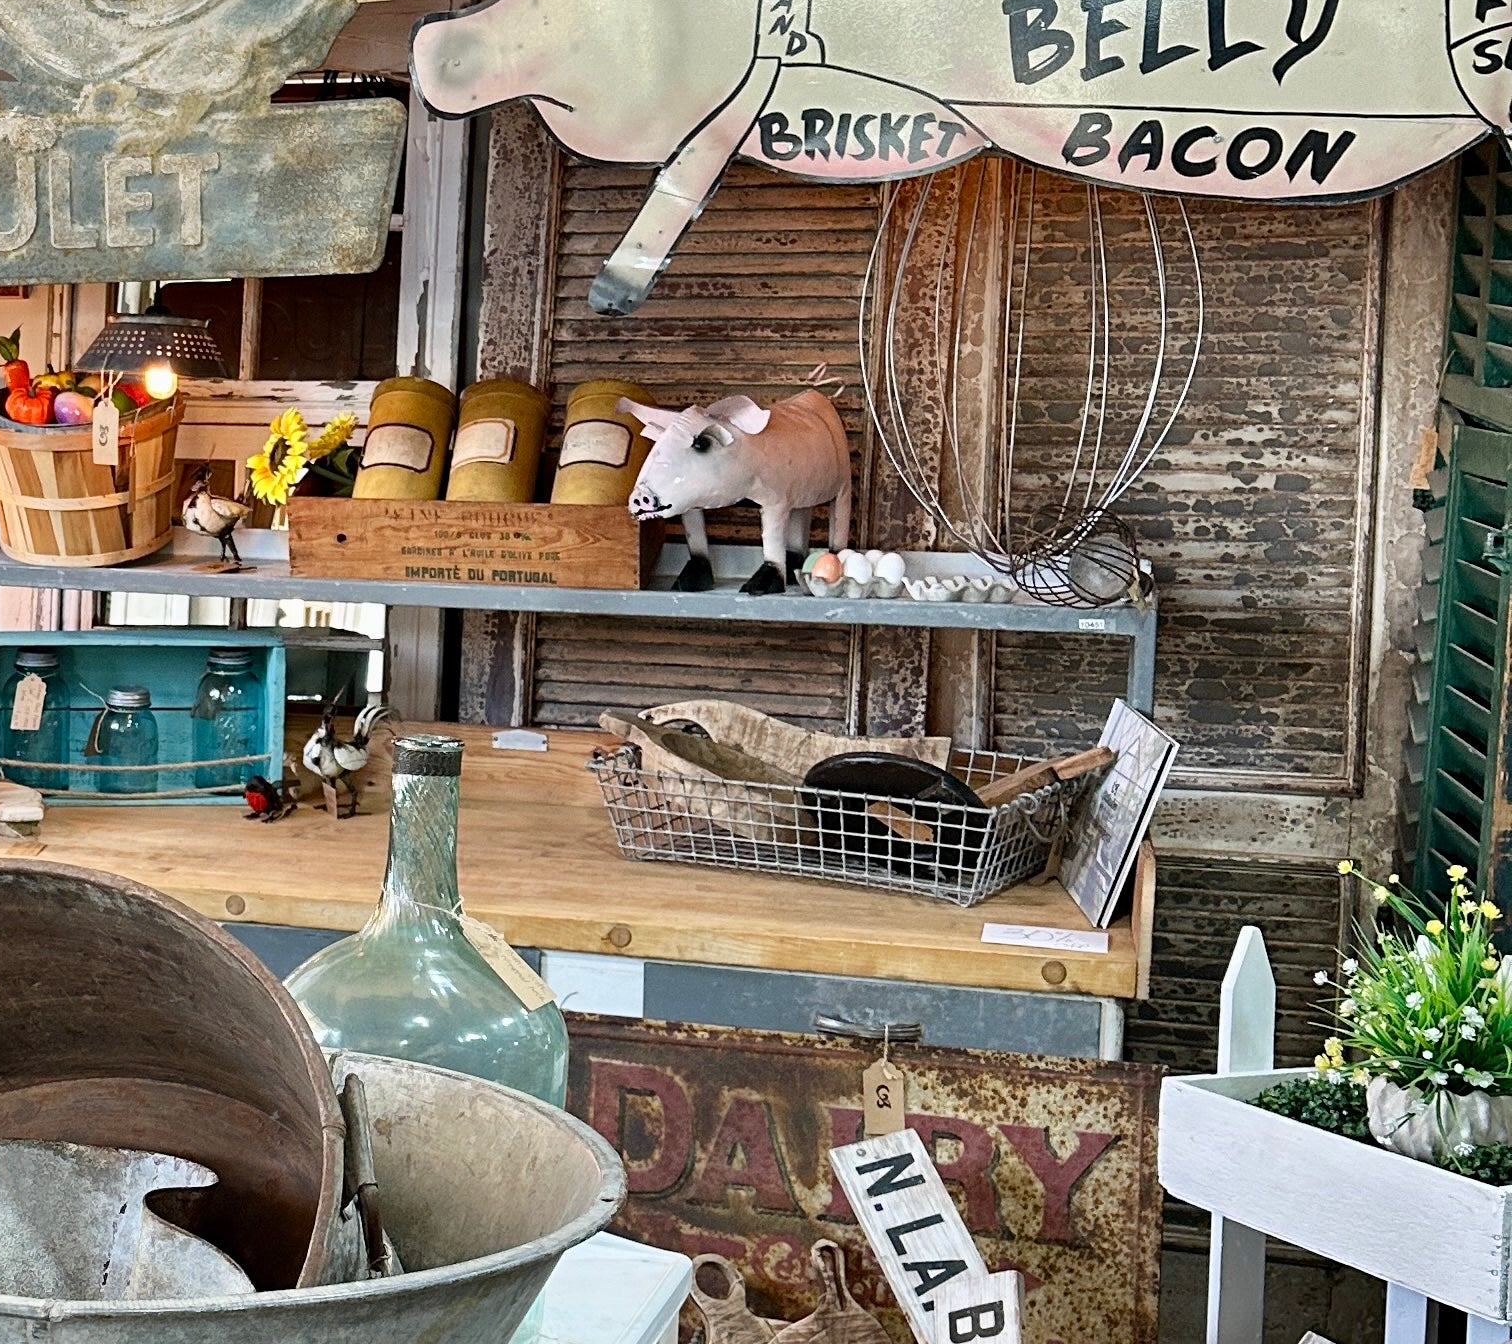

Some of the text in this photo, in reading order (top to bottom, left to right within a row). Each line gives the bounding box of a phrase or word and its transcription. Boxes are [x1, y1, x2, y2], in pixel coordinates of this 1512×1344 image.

[757, 106, 969, 165] BRISKET
[1061, 112, 1358, 187] BACON
[468, 568, 484, 581] DU
[491, 569, 557, 584] PORTUGAL
[855, 1152, 927, 1213] N.
